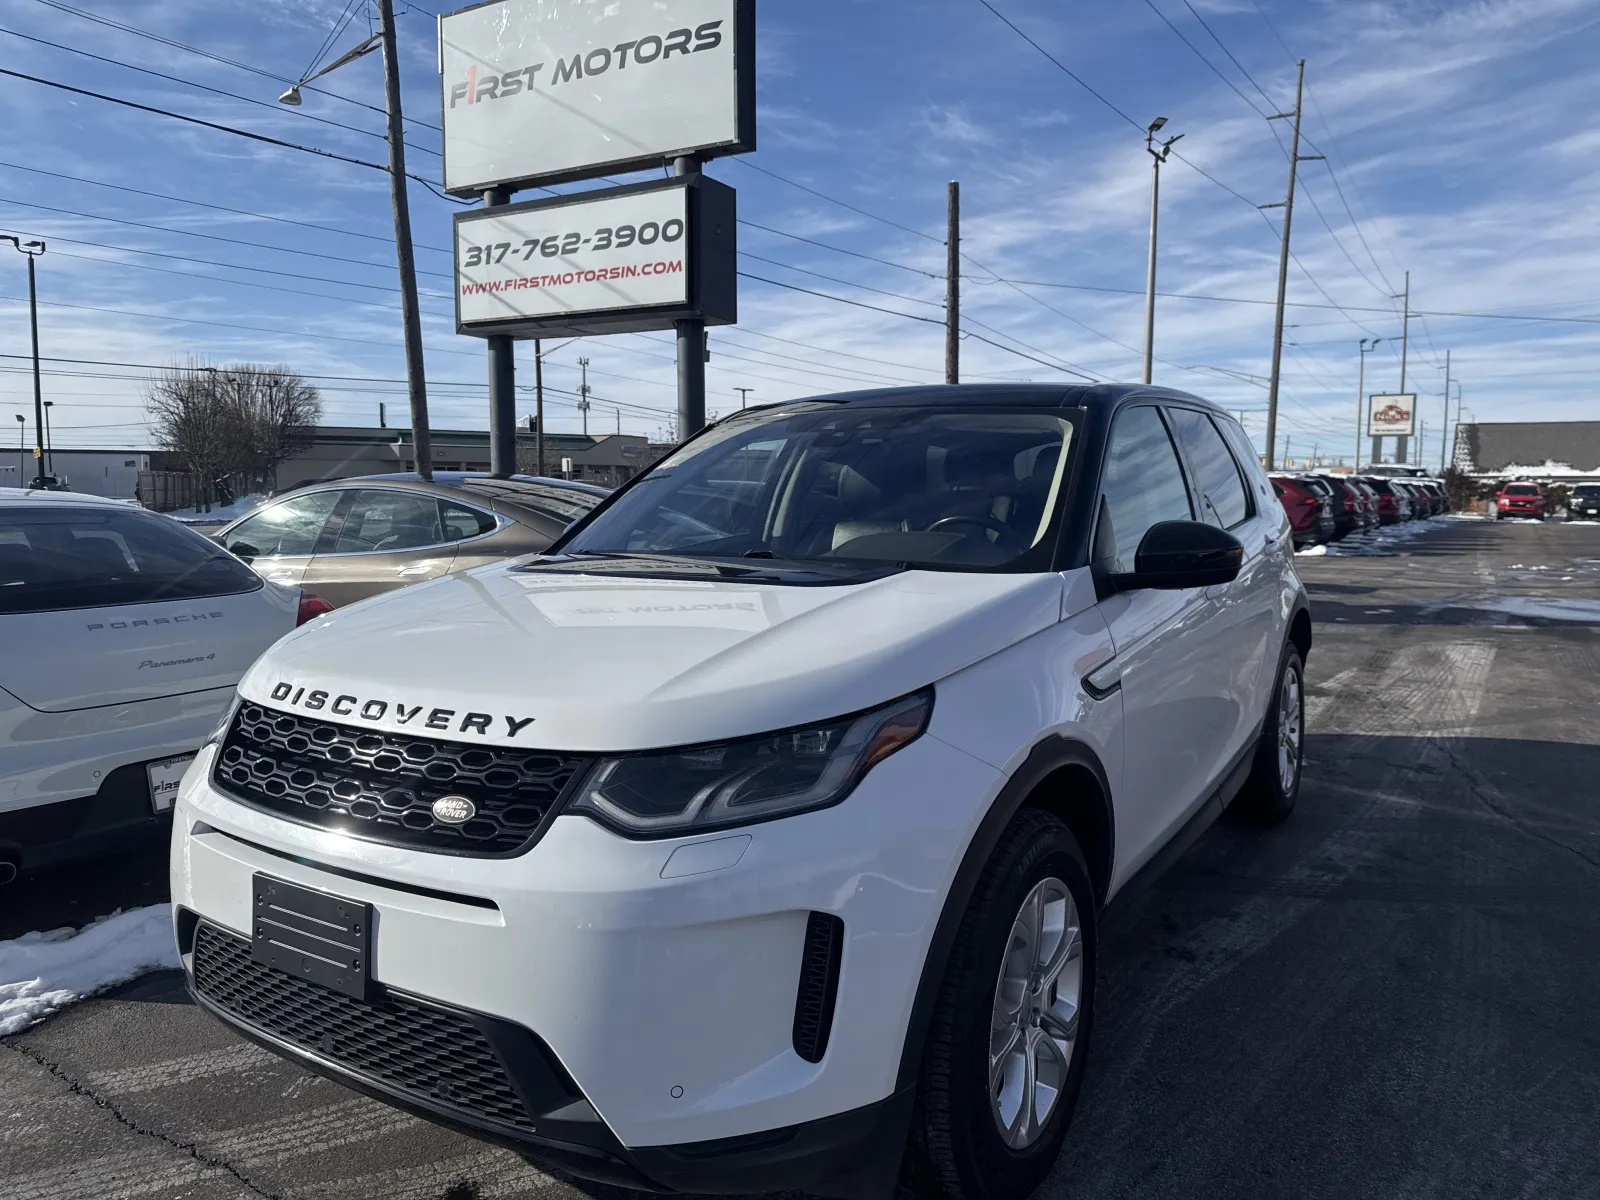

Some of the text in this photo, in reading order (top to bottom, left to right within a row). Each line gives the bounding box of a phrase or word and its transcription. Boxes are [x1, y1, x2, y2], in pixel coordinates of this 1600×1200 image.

[450, 19, 723, 109] FIRST MOTORS
[464, 218, 684, 268] 317-762-3900
[462, 260, 682, 295] WWW.FIRSTMOTORSIN.COM
[86, 611, 226, 632] PORSCHE
[138, 653, 216, 671] Panamera 4
[270, 681, 536, 738] DISCOVERY
[154, 780, 181, 793] FIRS
